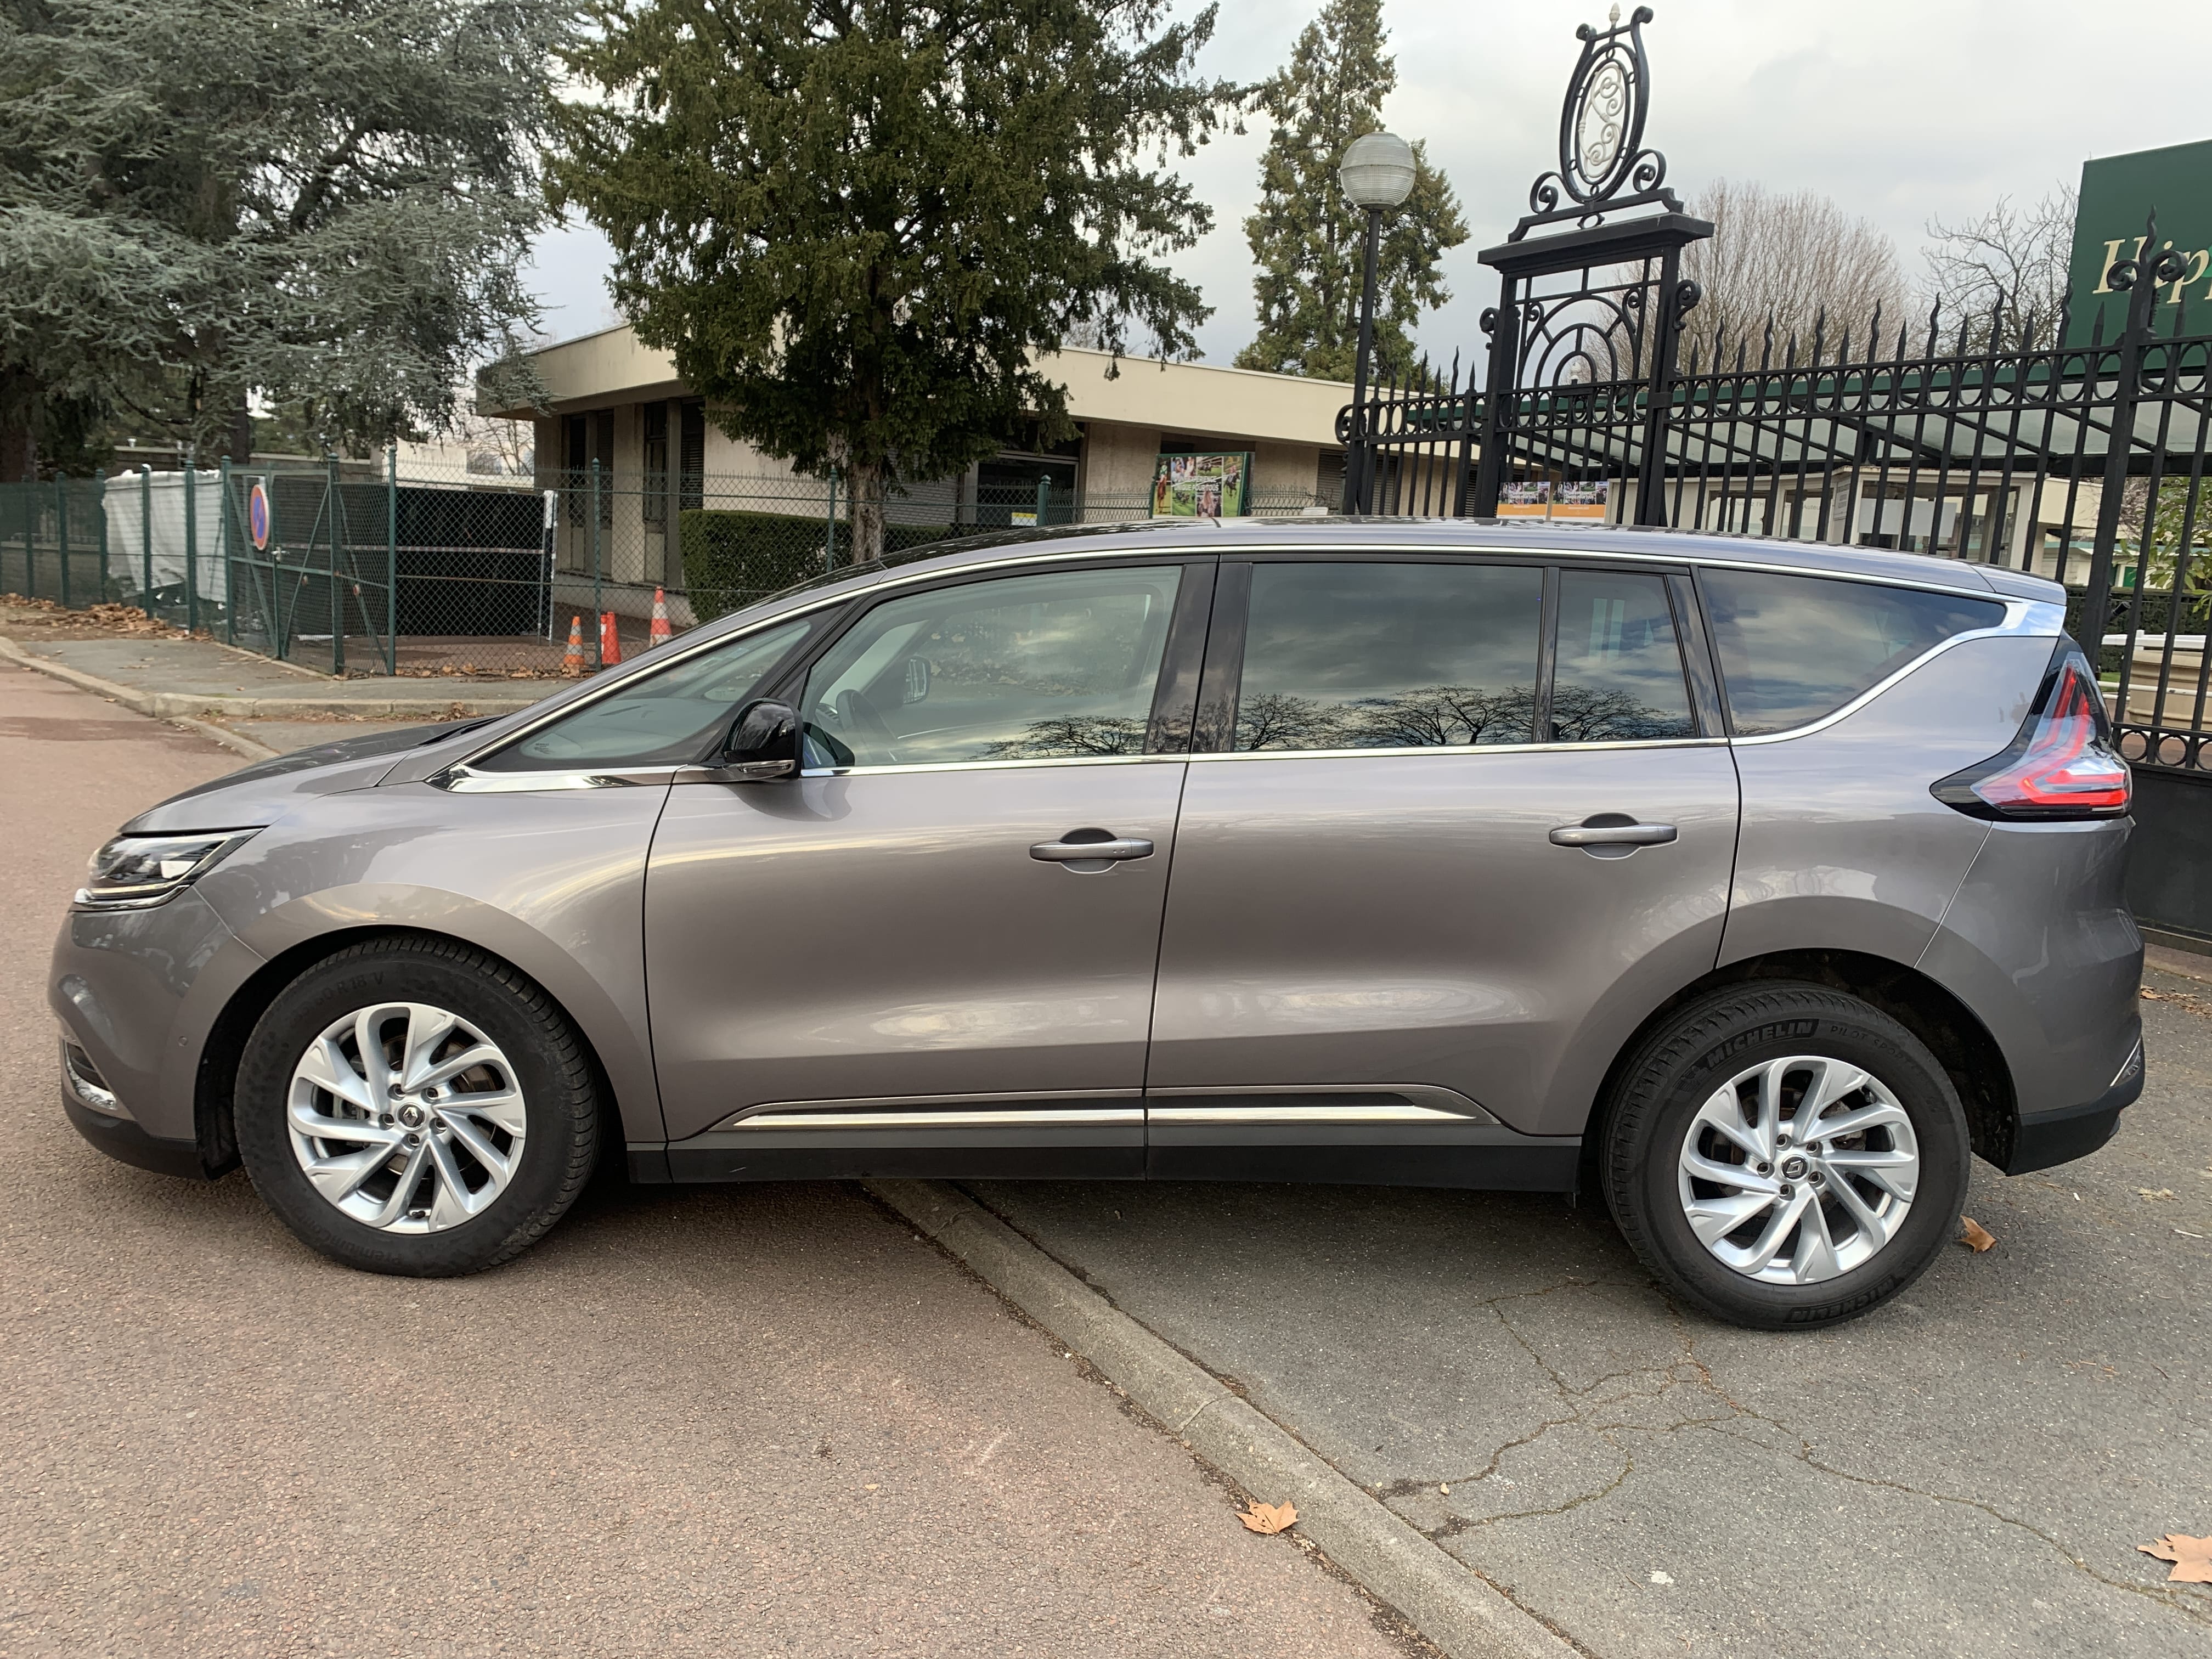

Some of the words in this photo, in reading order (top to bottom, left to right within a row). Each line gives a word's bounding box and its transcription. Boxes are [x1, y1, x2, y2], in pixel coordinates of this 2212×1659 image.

[2092, 236, 2212, 304] Hip
[1707, 1022, 1813, 1068] MICHELIN
[1830, 1025, 1868, 1040] PILOT
[1791, 1278, 1895, 1322] MICHELIN
